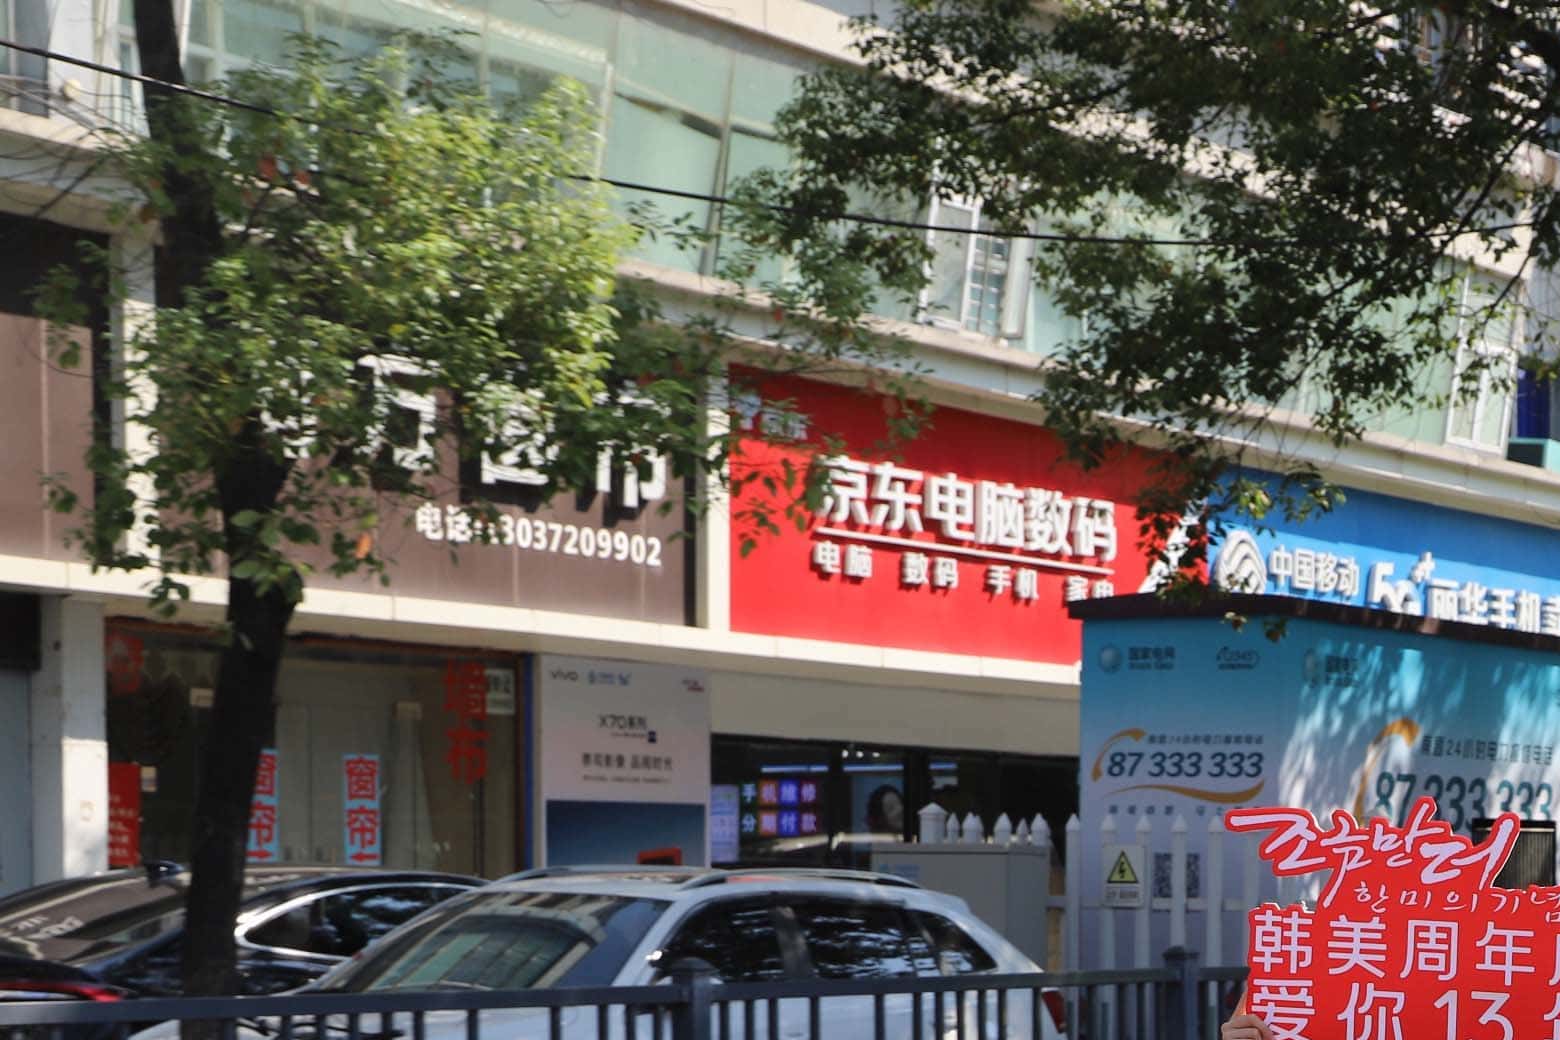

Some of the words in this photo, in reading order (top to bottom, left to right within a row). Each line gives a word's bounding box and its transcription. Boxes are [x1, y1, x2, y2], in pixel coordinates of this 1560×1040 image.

[815, 454, 1117, 562] 京东电脑数码
[813, 541, 873, 577] 电脑
[902, 551, 959, 588] 数码
[986, 564, 1039, 601] 手机
[1270, 544, 1359, 596] 中国移动
[550, 669, 579, 682] vivo
[1107, 752, 1143, 777] 87
[1148, 751, 1203, 778] 333
[1207, 751, 1264, 778] 333
[345, 757, 378, 848] 窗帘
